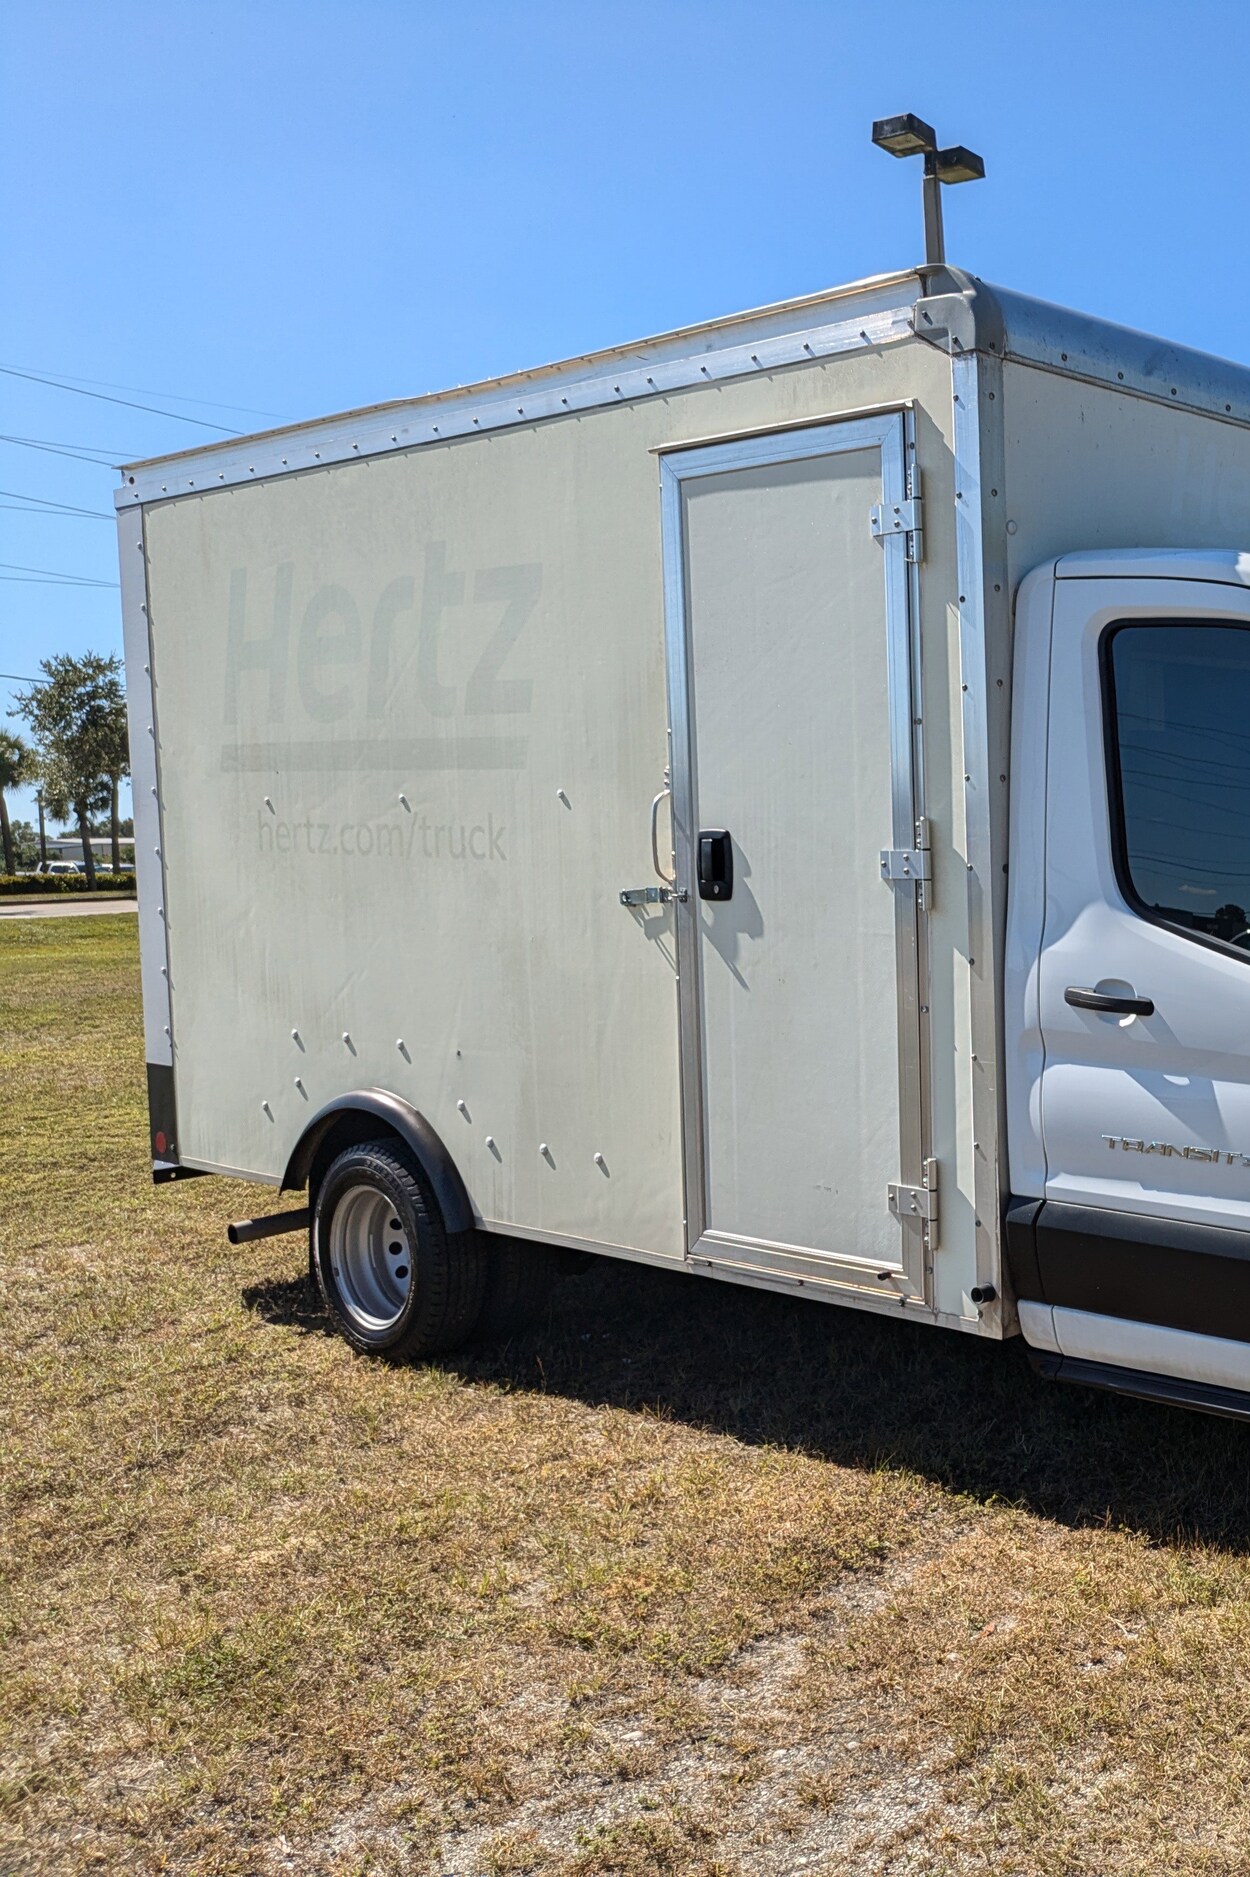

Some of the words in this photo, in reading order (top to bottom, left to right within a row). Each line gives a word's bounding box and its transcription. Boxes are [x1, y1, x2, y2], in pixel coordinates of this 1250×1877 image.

[223, 540, 543, 725] Hertz
[256, 809, 507, 861] hertz.com/truck
[1101, 1134, 1243, 1165] TRANSIT
